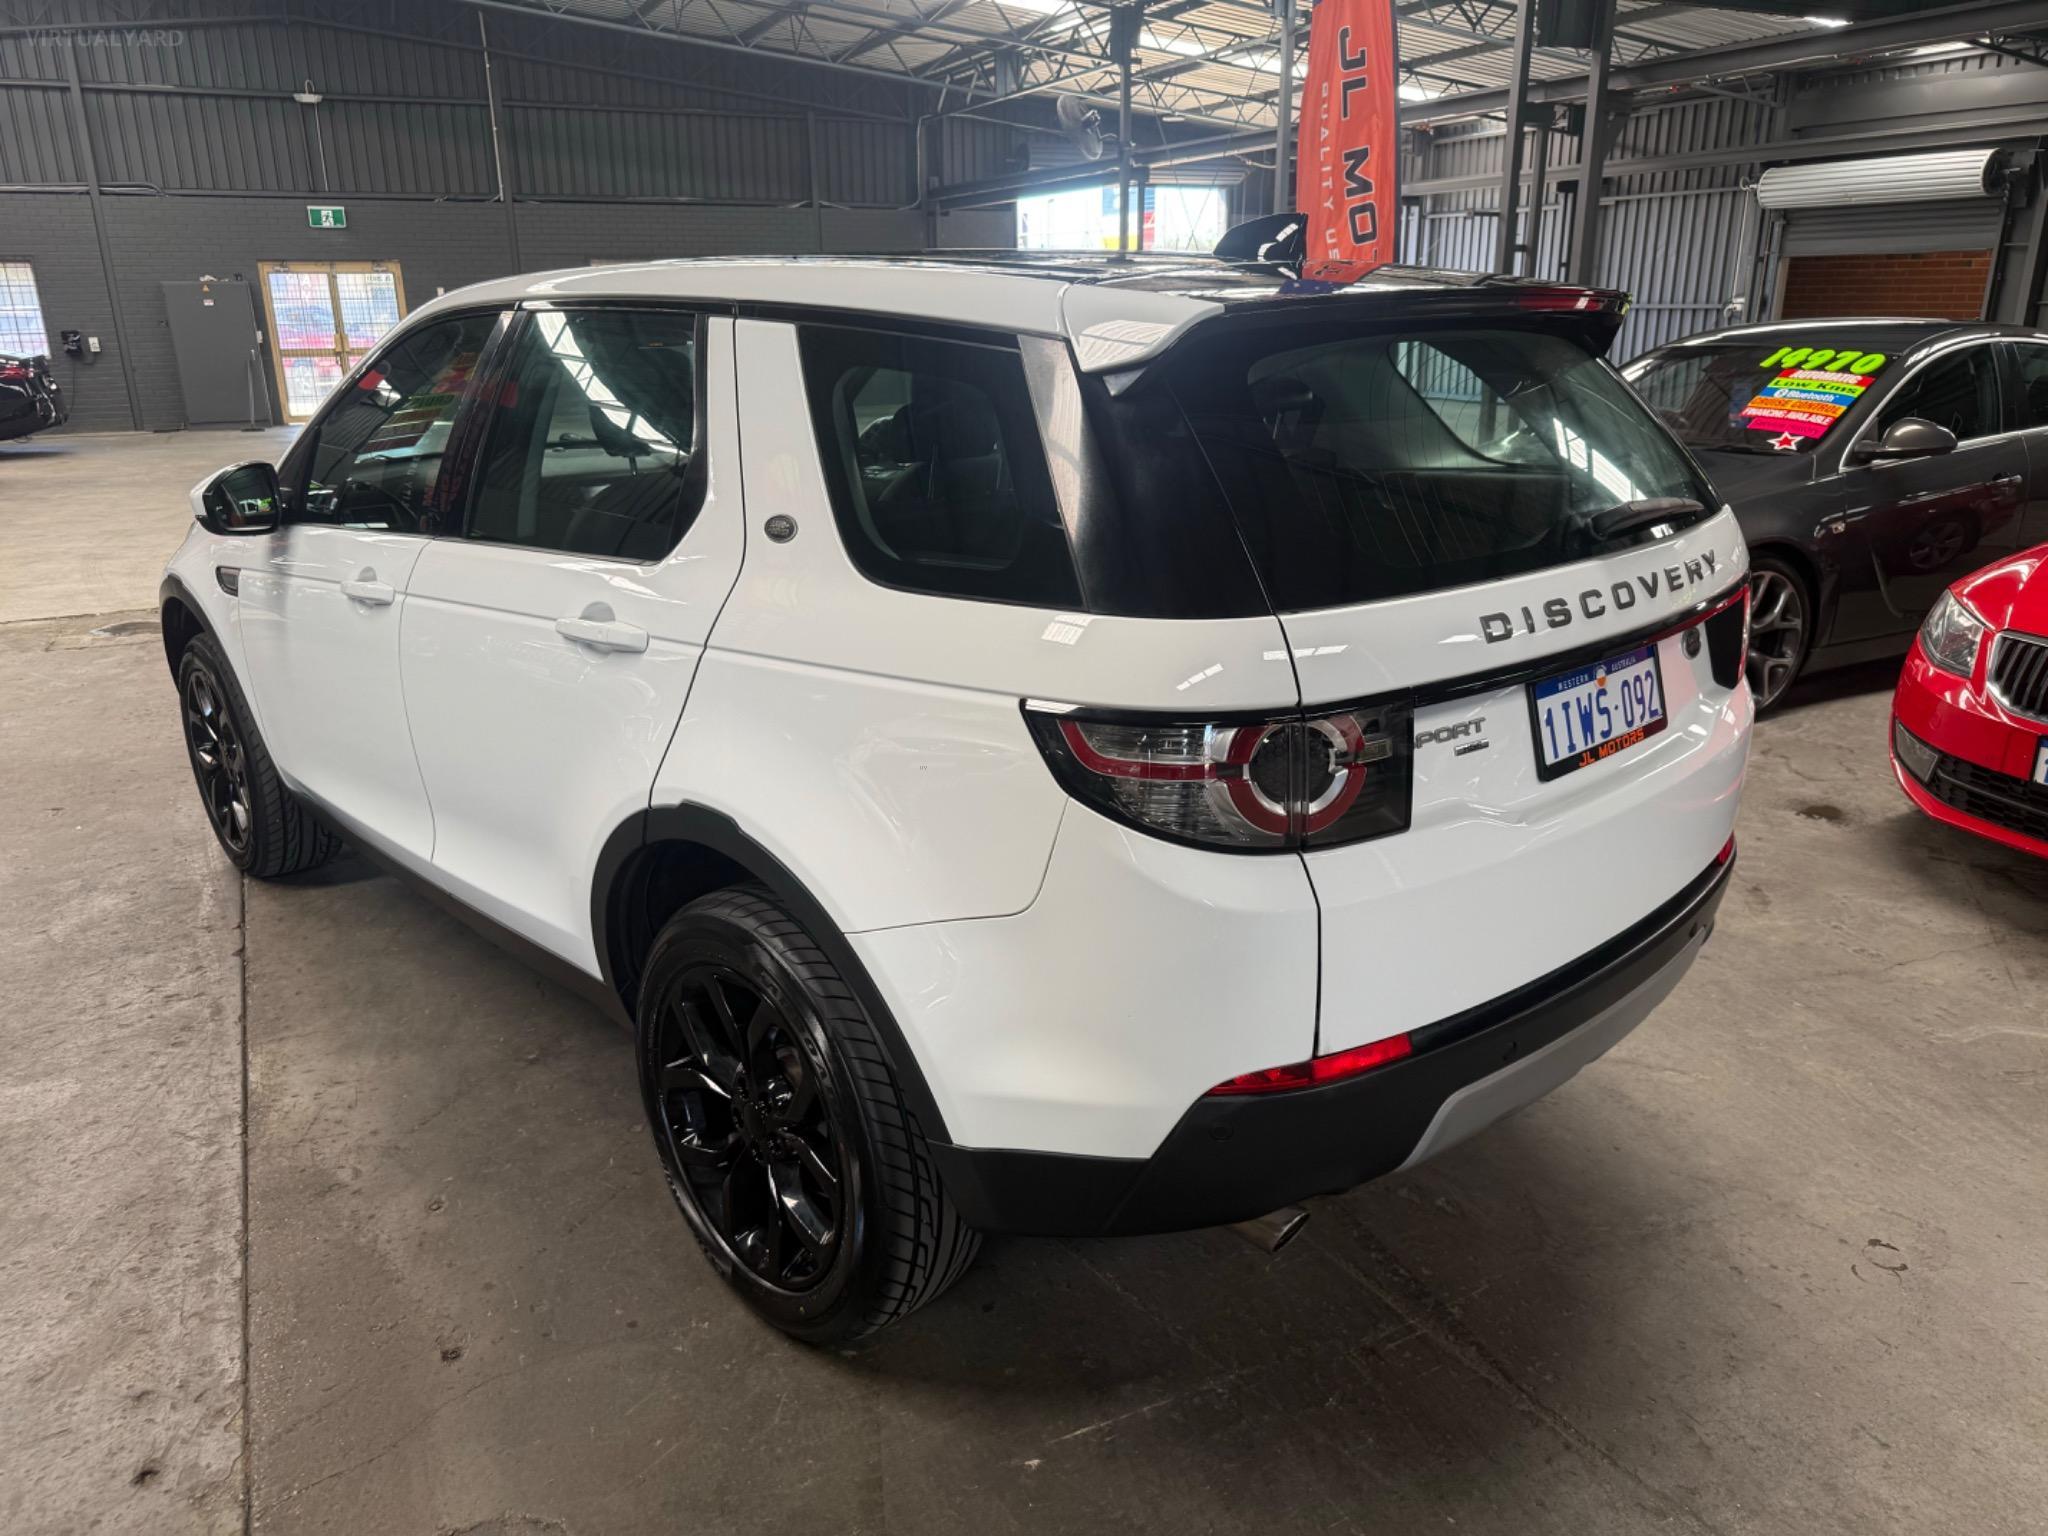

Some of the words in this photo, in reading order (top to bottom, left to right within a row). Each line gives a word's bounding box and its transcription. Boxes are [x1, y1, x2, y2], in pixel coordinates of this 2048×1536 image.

[1338, 26, 1367, 121] JL
[1320, 82, 1336, 210] QUALITY
[1343, 145, 1378, 262] MO
[1760, 346, 1887, 375] 14970
[1479, 550, 1717, 644] DISCOVERY
[1558, 674, 1589, 691] WESTERN
[1611, 656, 1636, 671] AUSTRALIA
[1414, 717, 1487, 750] PORT
[1579, 751, 1595, 768] JL
[1599, 727, 1645, 758] MOTORS
